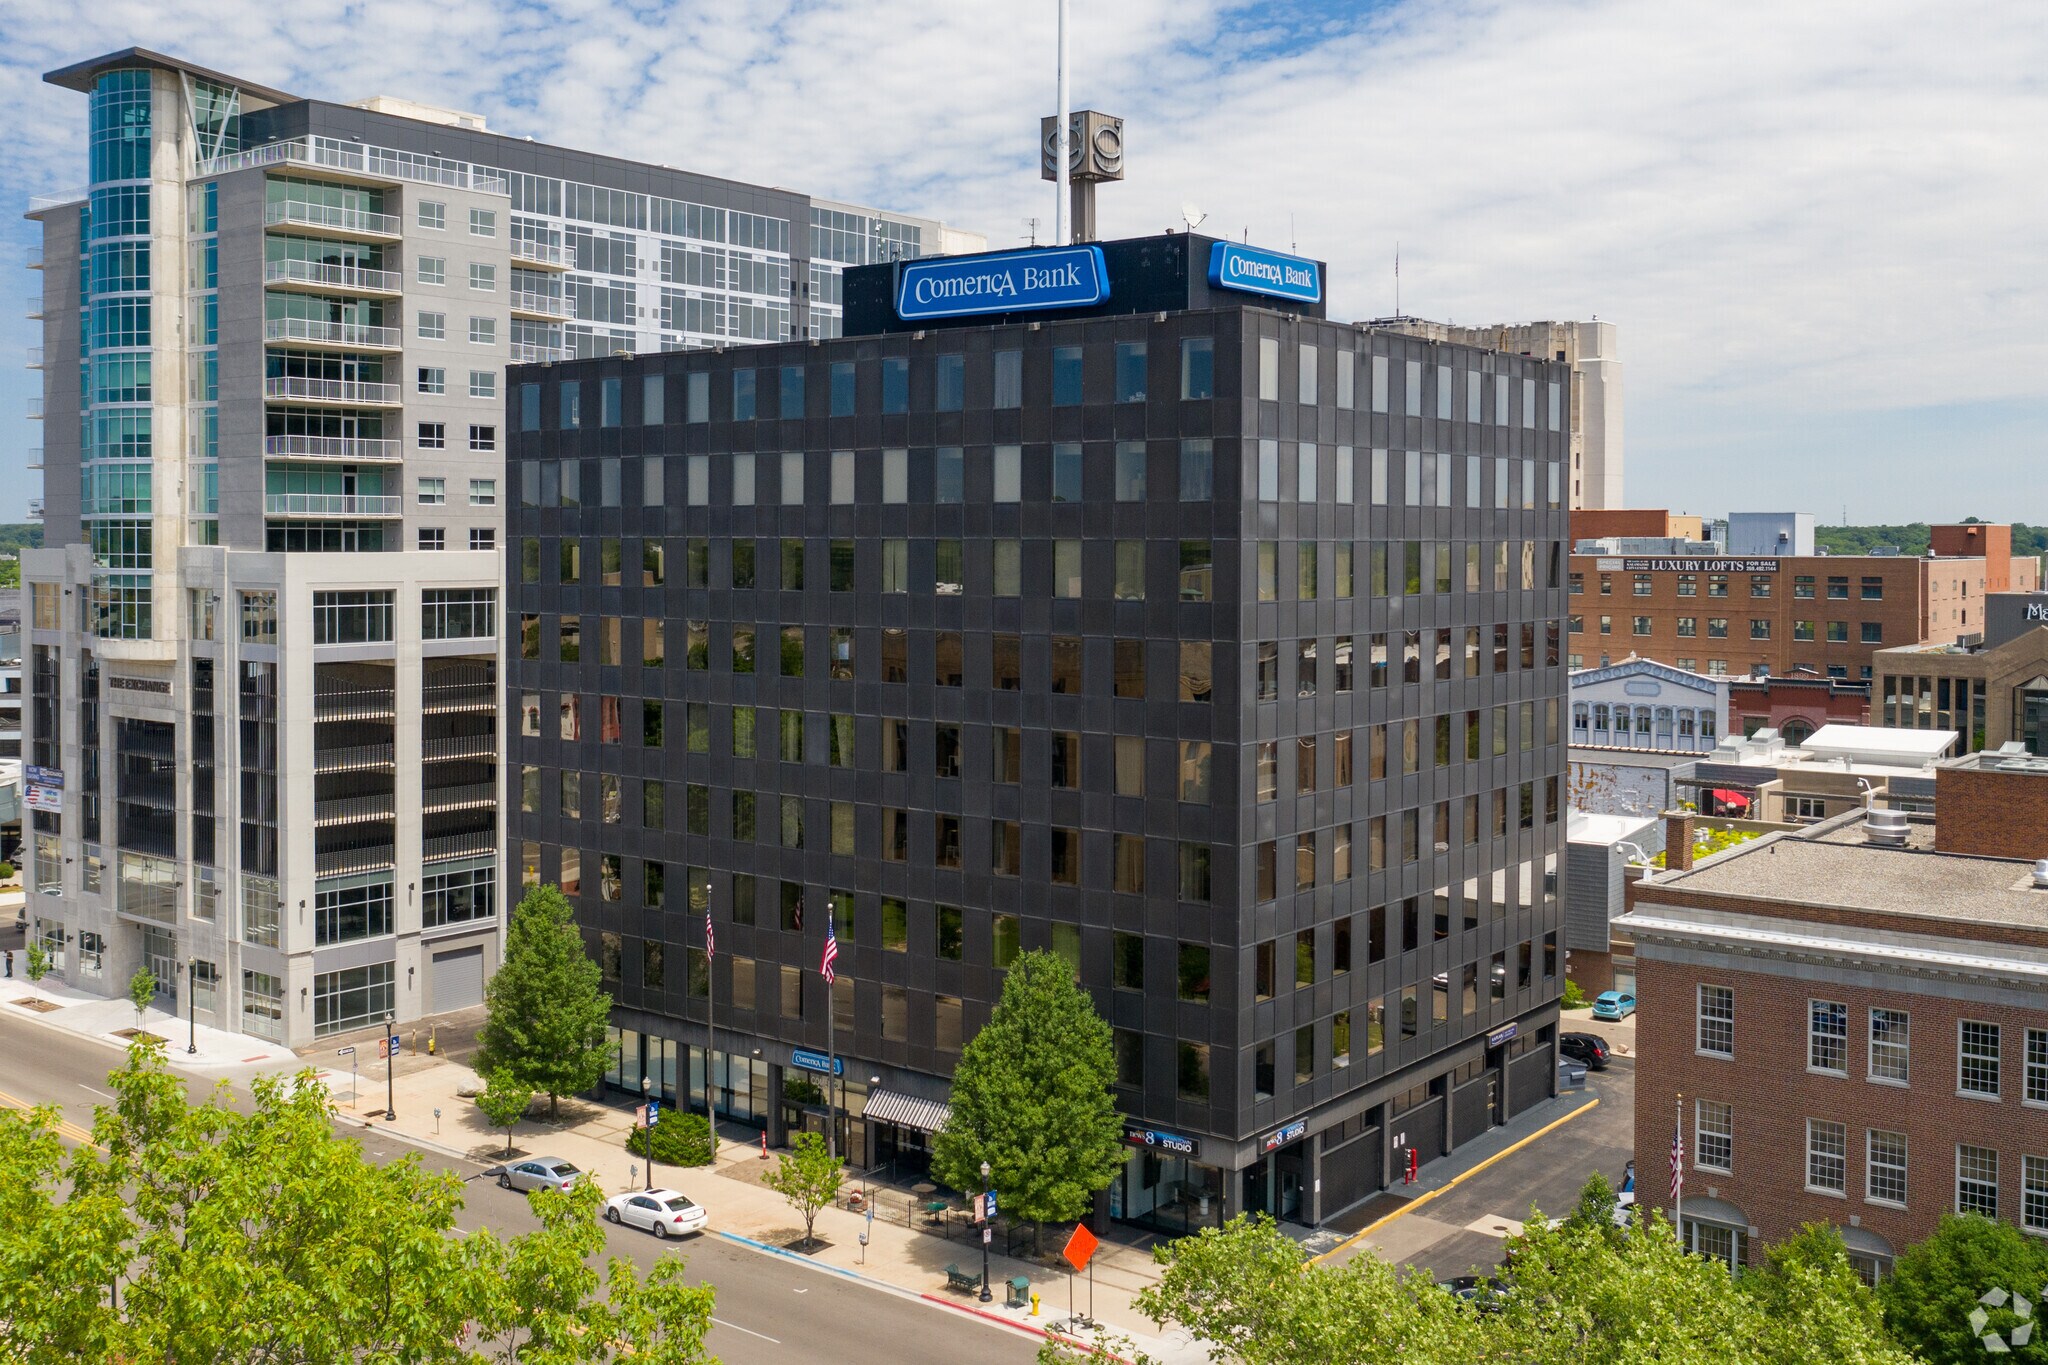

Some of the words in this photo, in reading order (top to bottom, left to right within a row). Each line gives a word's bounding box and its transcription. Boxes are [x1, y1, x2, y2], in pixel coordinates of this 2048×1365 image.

[1023, 262, 1082, 291] Bank
[1285, 266, 1313, 288] Bank
[1651, 560, 1701, 571] LUXURY
[1703, 560, 1744, 571] LOFTS
[109, 676, 125, 689] THE
[125, 678, 171, 694] EXCHANGE
[1129, 1130, 1145, 1140] news
[1145, 1131, 1155, 1145] 8
[1276, 1131, 1283, 1145] 8
[1286, 1126, 1304, 1140] STUDIO
[1162, 1139, 1192, 1153] STUDIO
